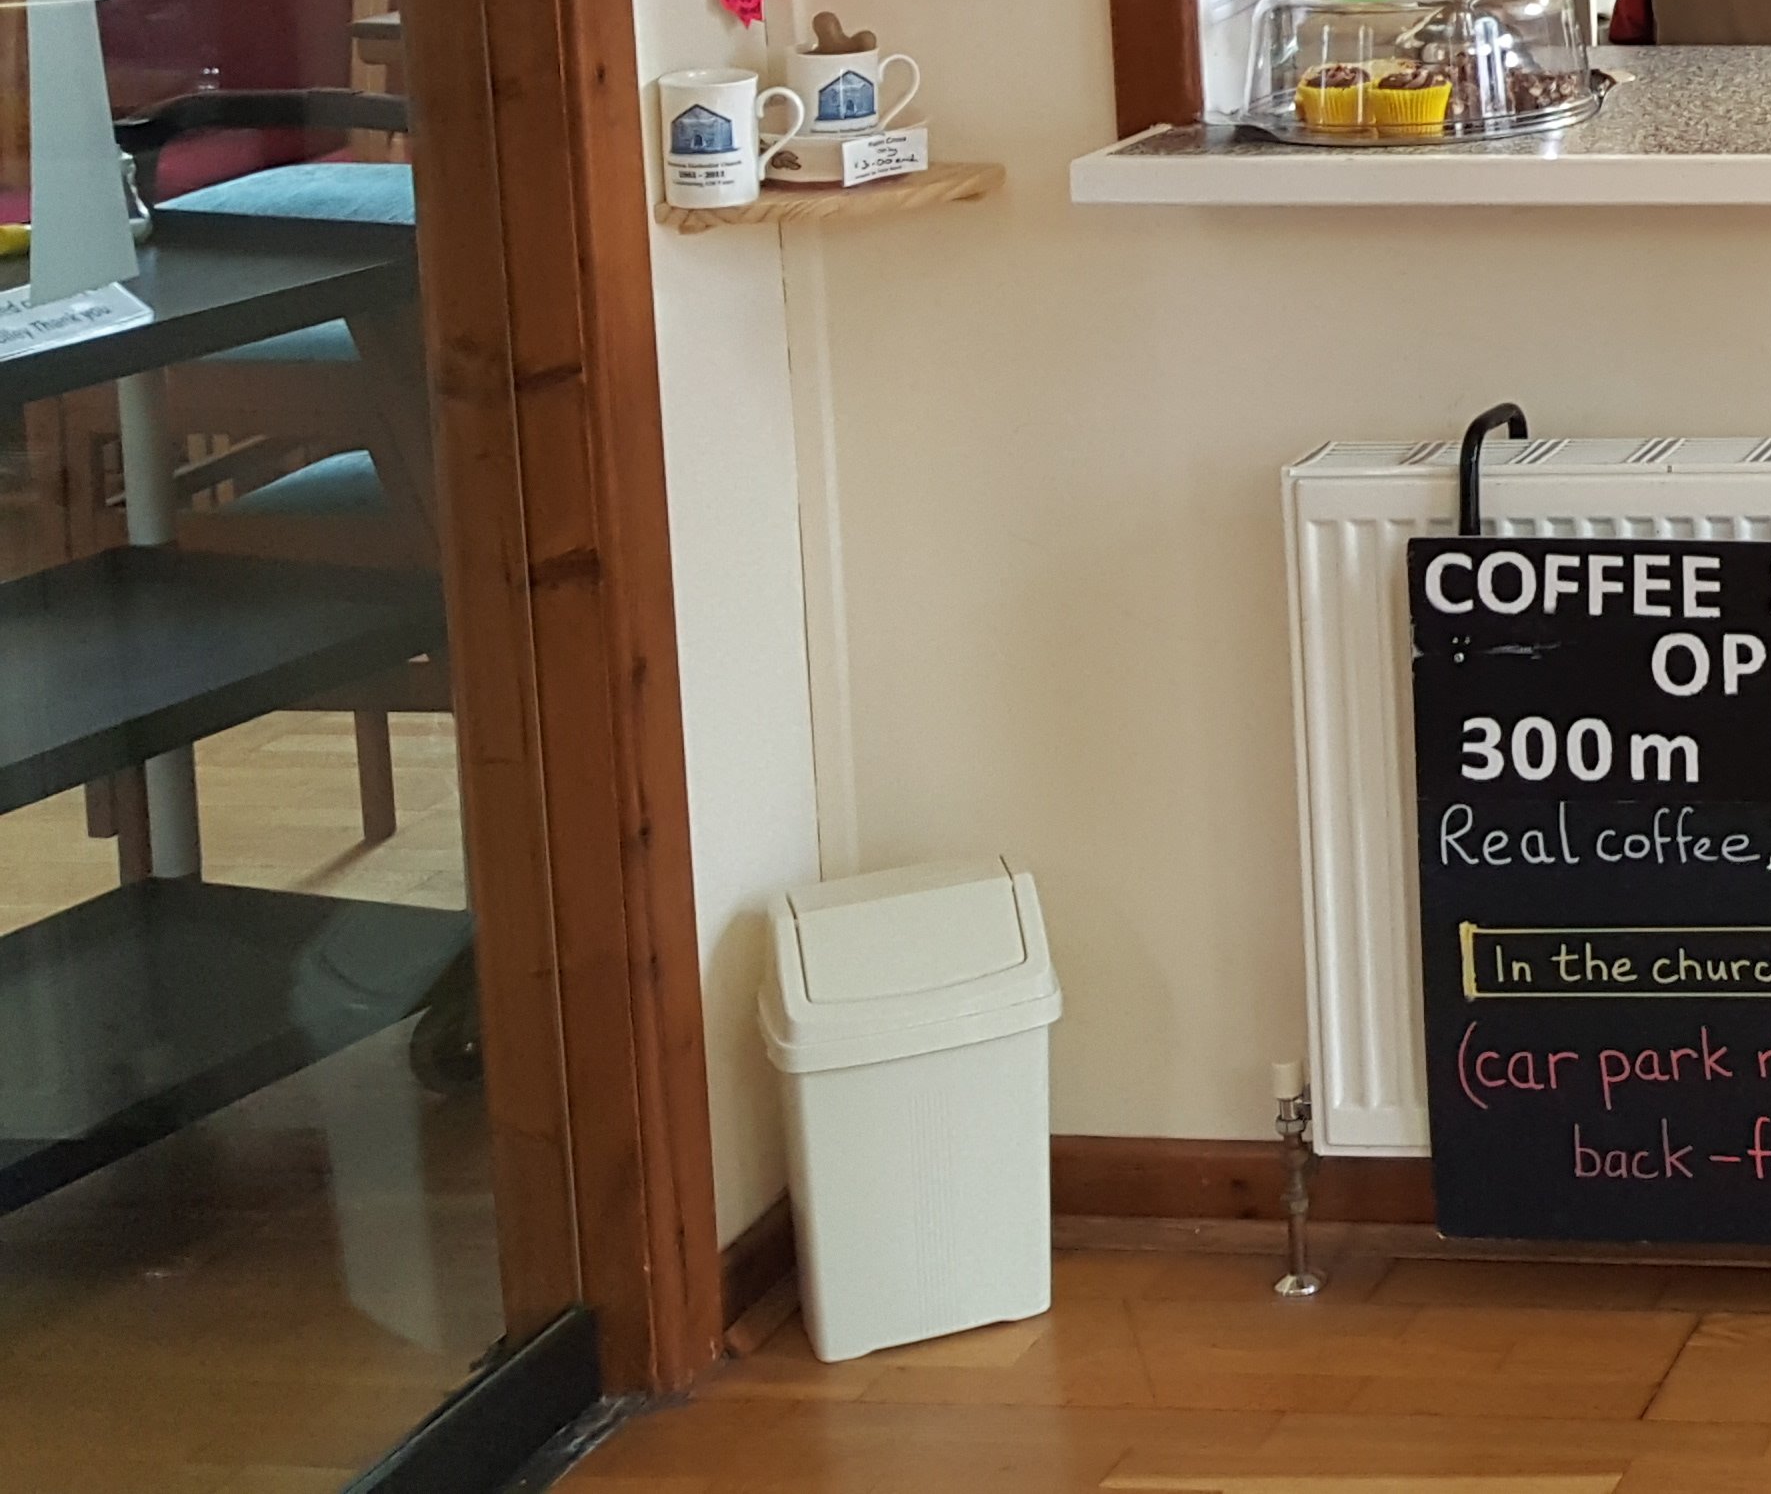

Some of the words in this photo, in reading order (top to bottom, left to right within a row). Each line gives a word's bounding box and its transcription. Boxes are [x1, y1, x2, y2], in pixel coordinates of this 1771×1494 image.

[30, 312, 76, 332] Thank
[87, 305, 110, 319] you
[1425, 551, 1721, 617] COFFEE
[1440, 802, 1578, 867] Real
[1496, 944, 1531, 983] In
[1550, 944, 1637, 982] the
[1458, 1021, 1578, 1109] (car
[1600, 1026, 1731, 1110] park
[1573, 1118, 1693, 1180] back
